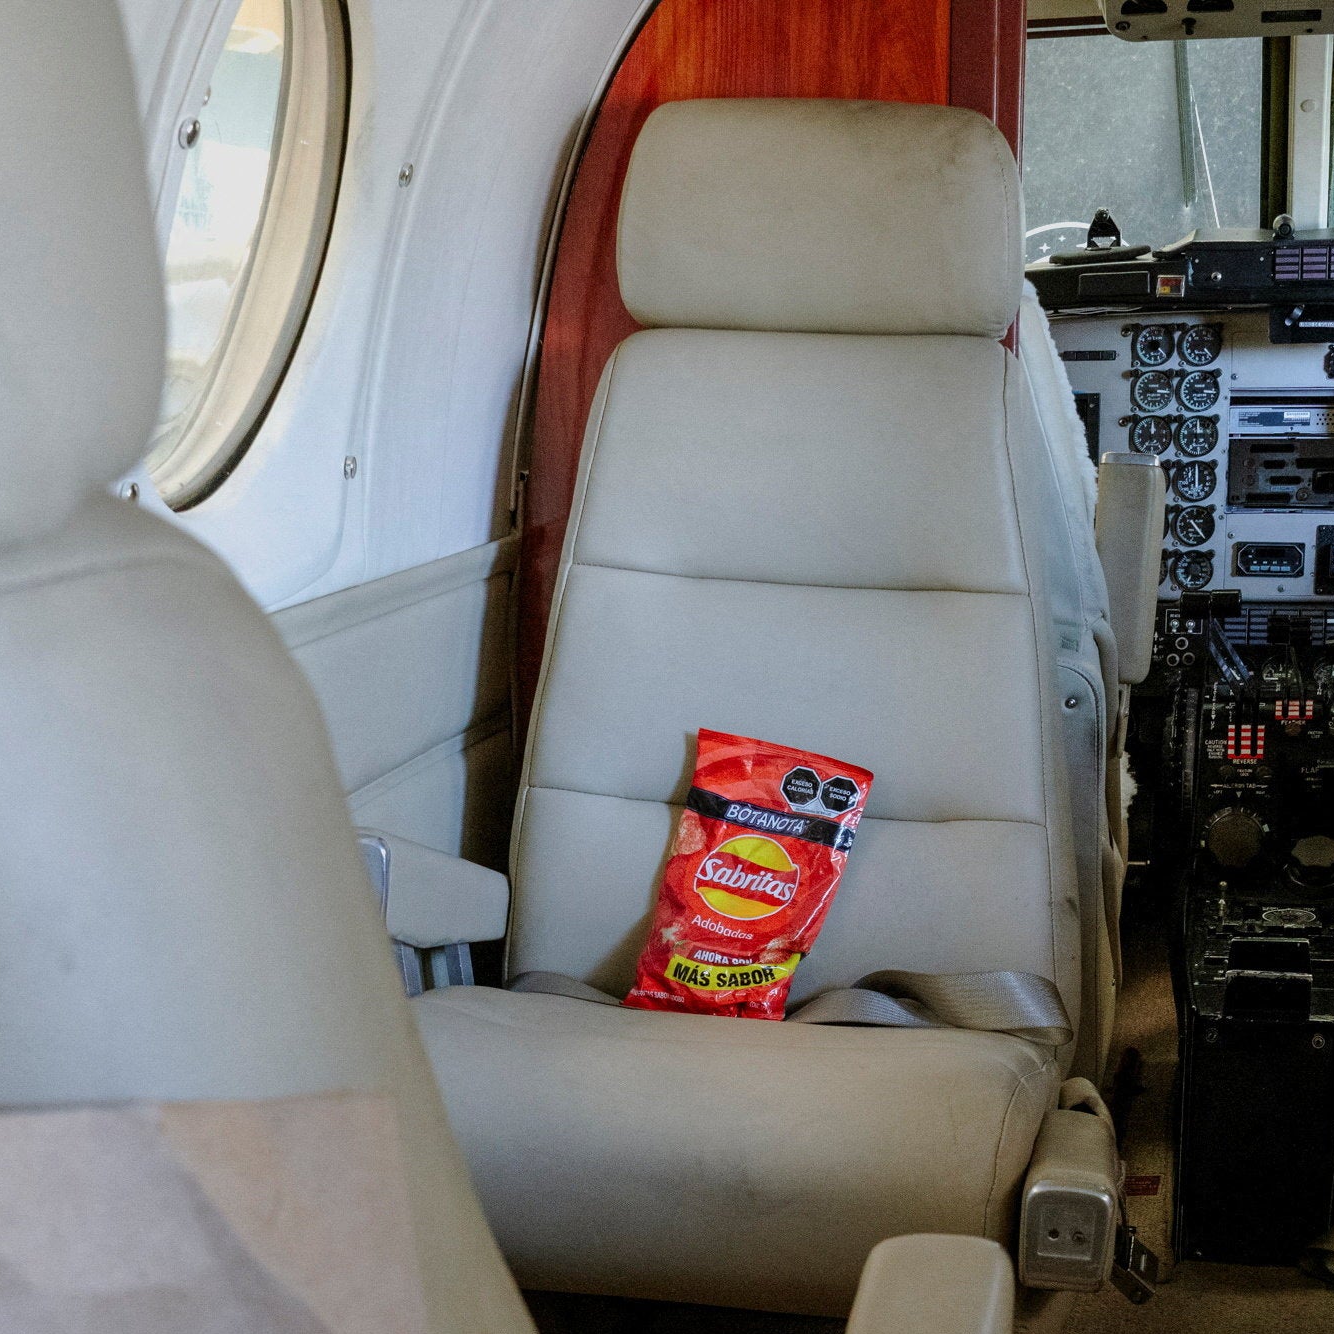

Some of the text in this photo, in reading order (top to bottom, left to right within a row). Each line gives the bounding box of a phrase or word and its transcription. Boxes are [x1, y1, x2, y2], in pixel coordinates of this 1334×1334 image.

[791, 779, 813, 788] EXCESO
[829, 787, 851, 796] EXCESO
[829, 793, 847, 802] SODIO
[725, 804, 806, 834] BOTANOTA
[695, 857, 796, 902] Sabritas
[692, 914, 754, 940] Adobadas
[694, 949, 729, 965] AHORA
[673, 962, 776, 988] MÁS SABOR
